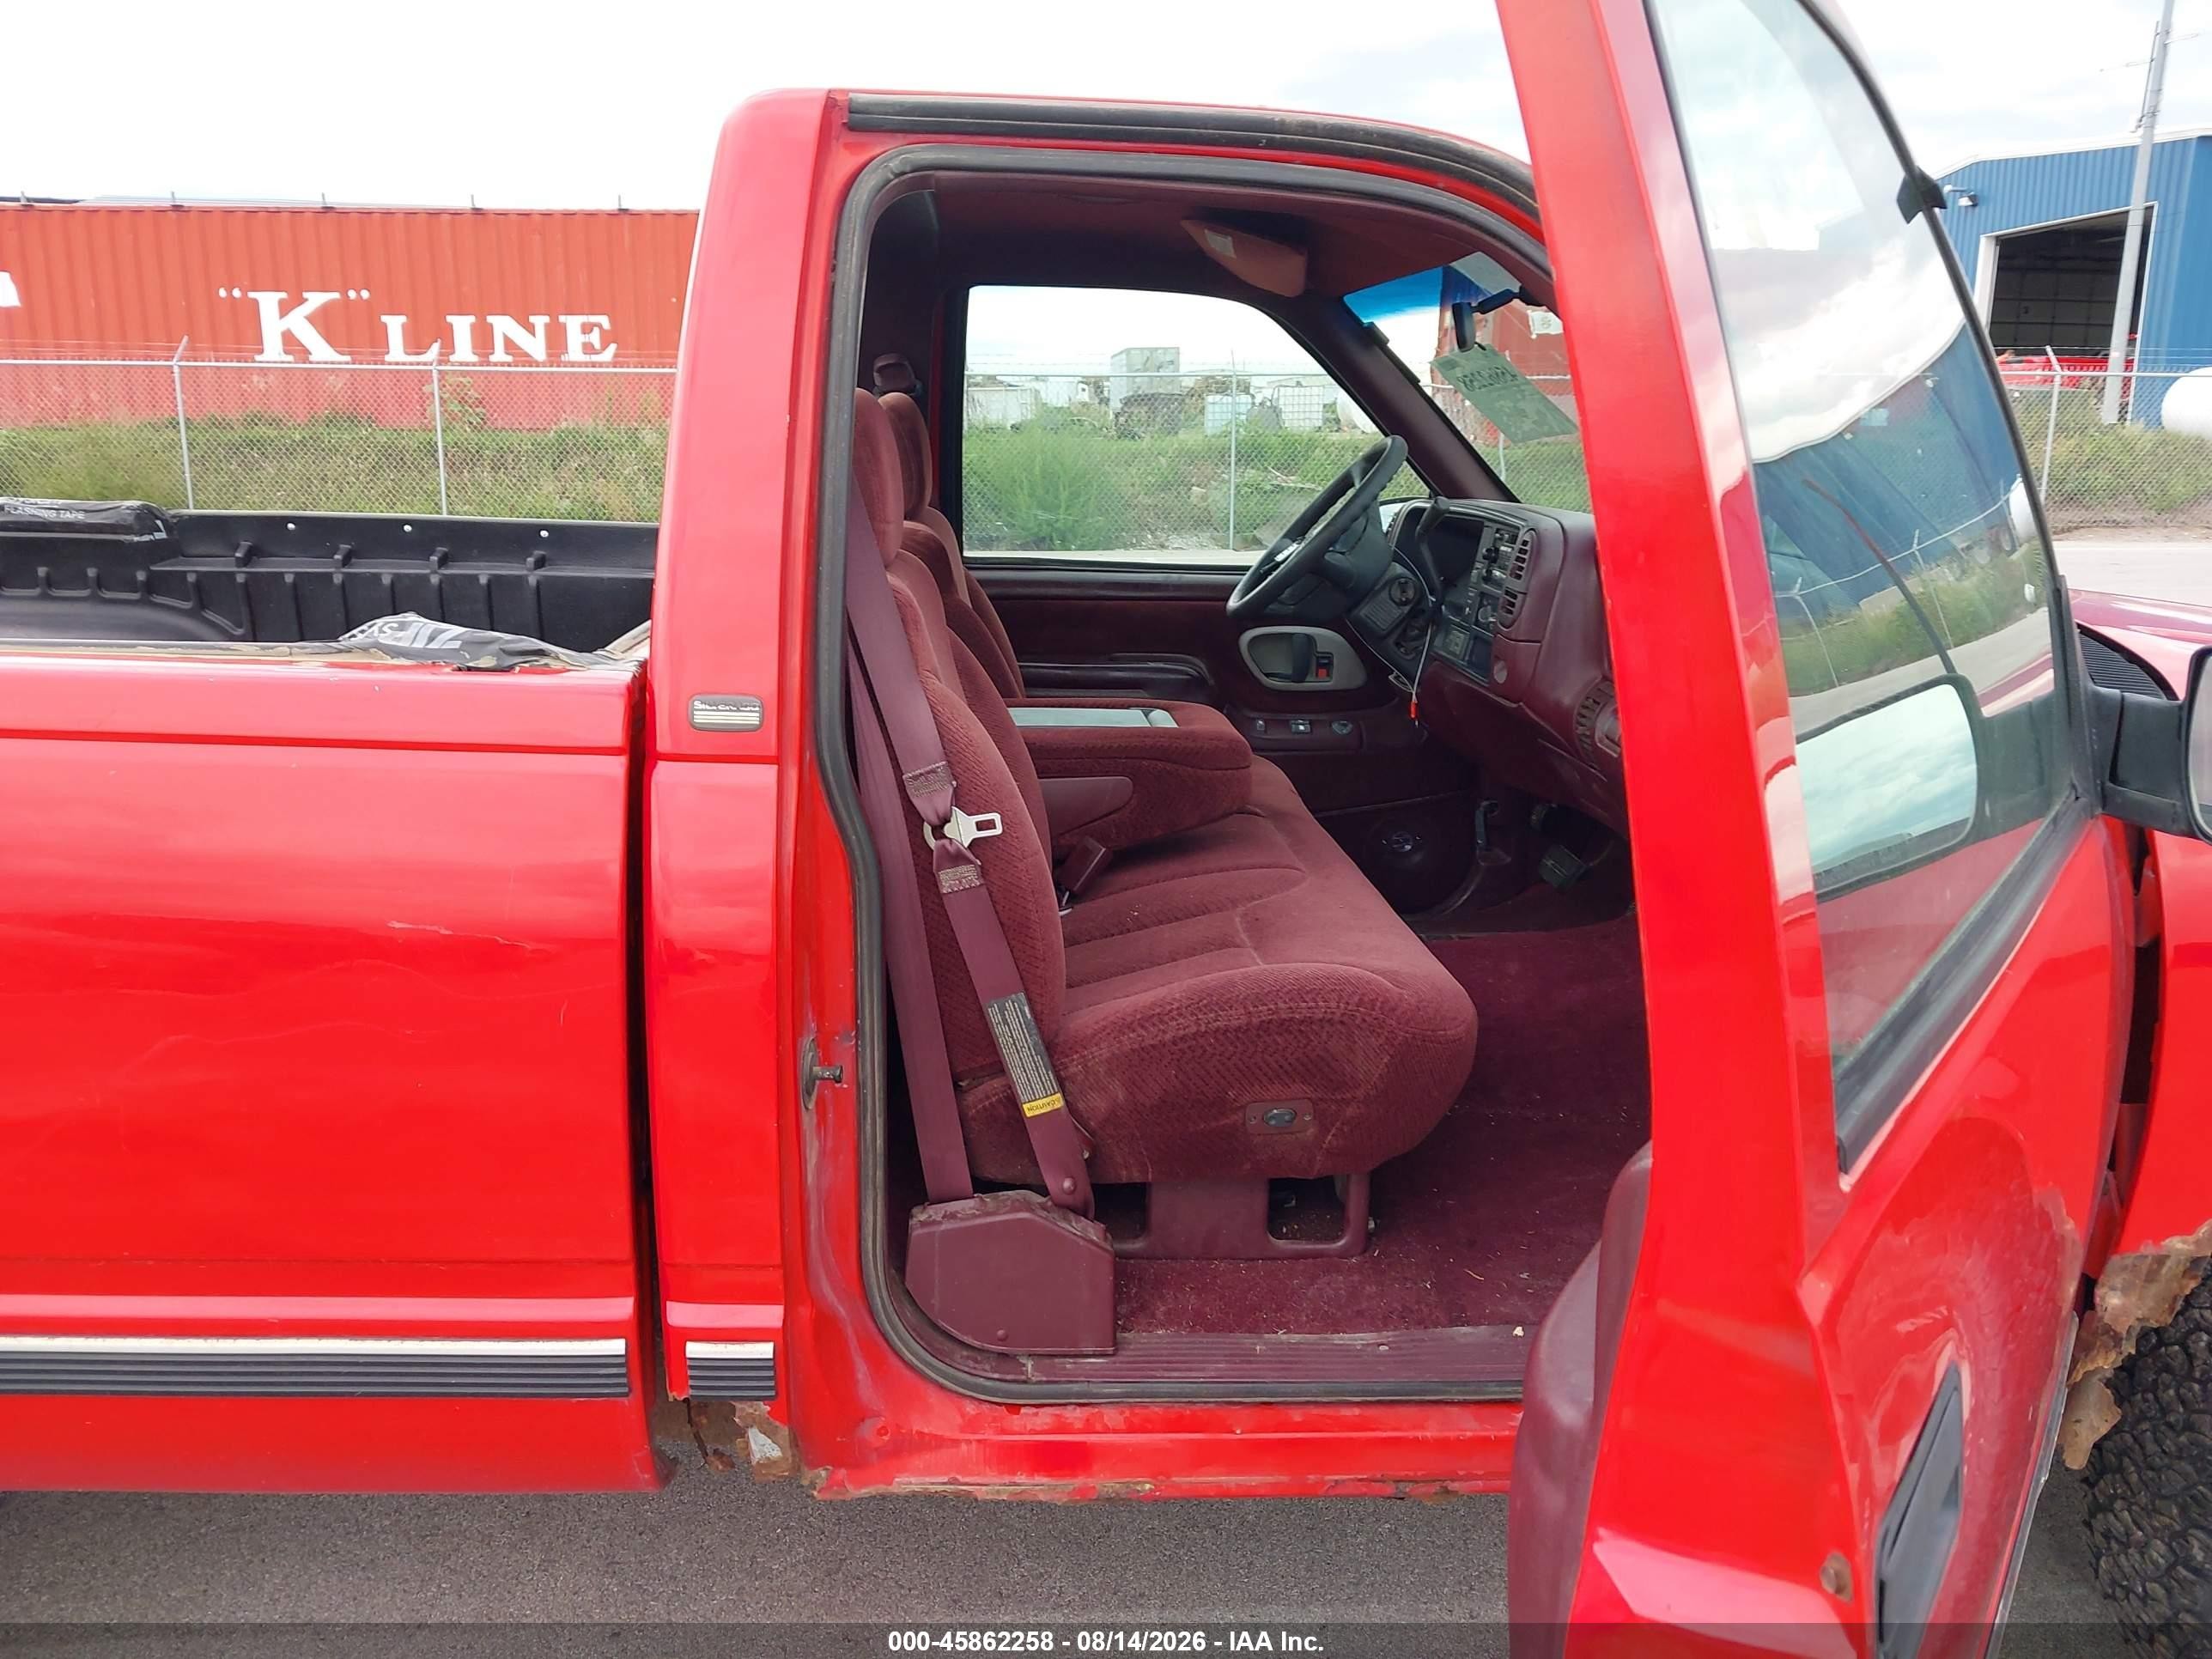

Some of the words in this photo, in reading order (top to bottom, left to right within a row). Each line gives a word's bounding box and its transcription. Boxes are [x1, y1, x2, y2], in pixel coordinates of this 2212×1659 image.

[380, 314, 618, 362] LINE
[4, 505, 58, 519] FLASHING
[60, 509, 86, 520] TAPE
[377, 622, 469, 649] ZIP
[1026, 1099, 1056, 1112] CAUTION
